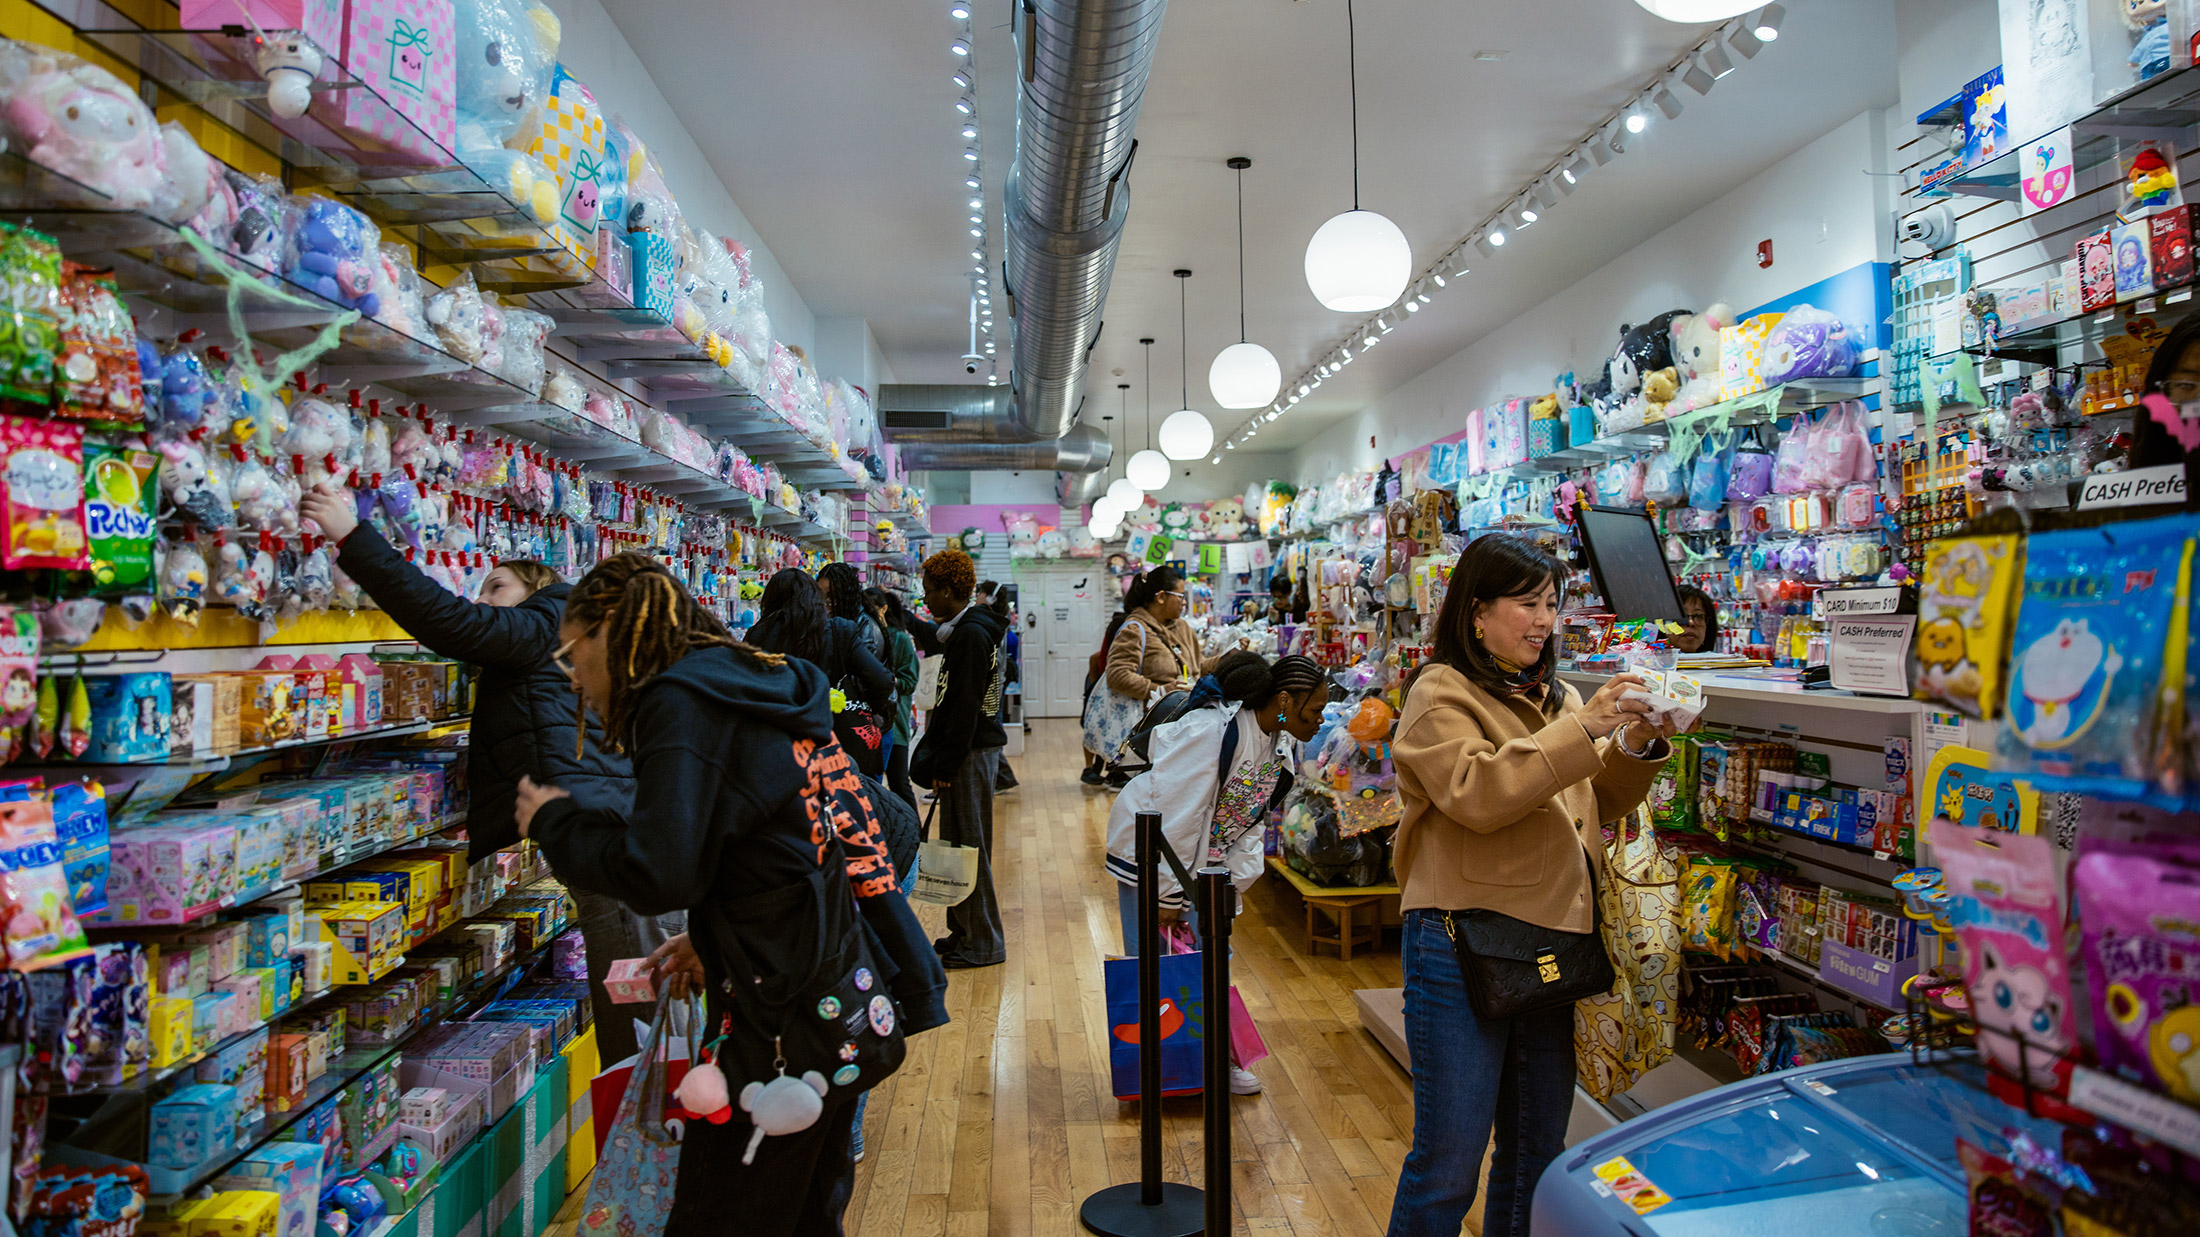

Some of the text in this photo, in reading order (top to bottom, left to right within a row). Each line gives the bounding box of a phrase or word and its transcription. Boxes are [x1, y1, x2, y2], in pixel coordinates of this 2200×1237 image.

[1923, 161, 1962, 186] HELLO KITTY
[2085, 481, 2132, 502] CASH
[1151, 541, 1167, 560] S
[1204, 549, 1216, 568] L
[1826, 597, 1897, 612] CARD Minimum $10
[1840, 626, 1905, 638] CASH Preferred
[1856, 966, 1880, 987] GUM
[1732, 1018, 1762, 1056] CORORO
